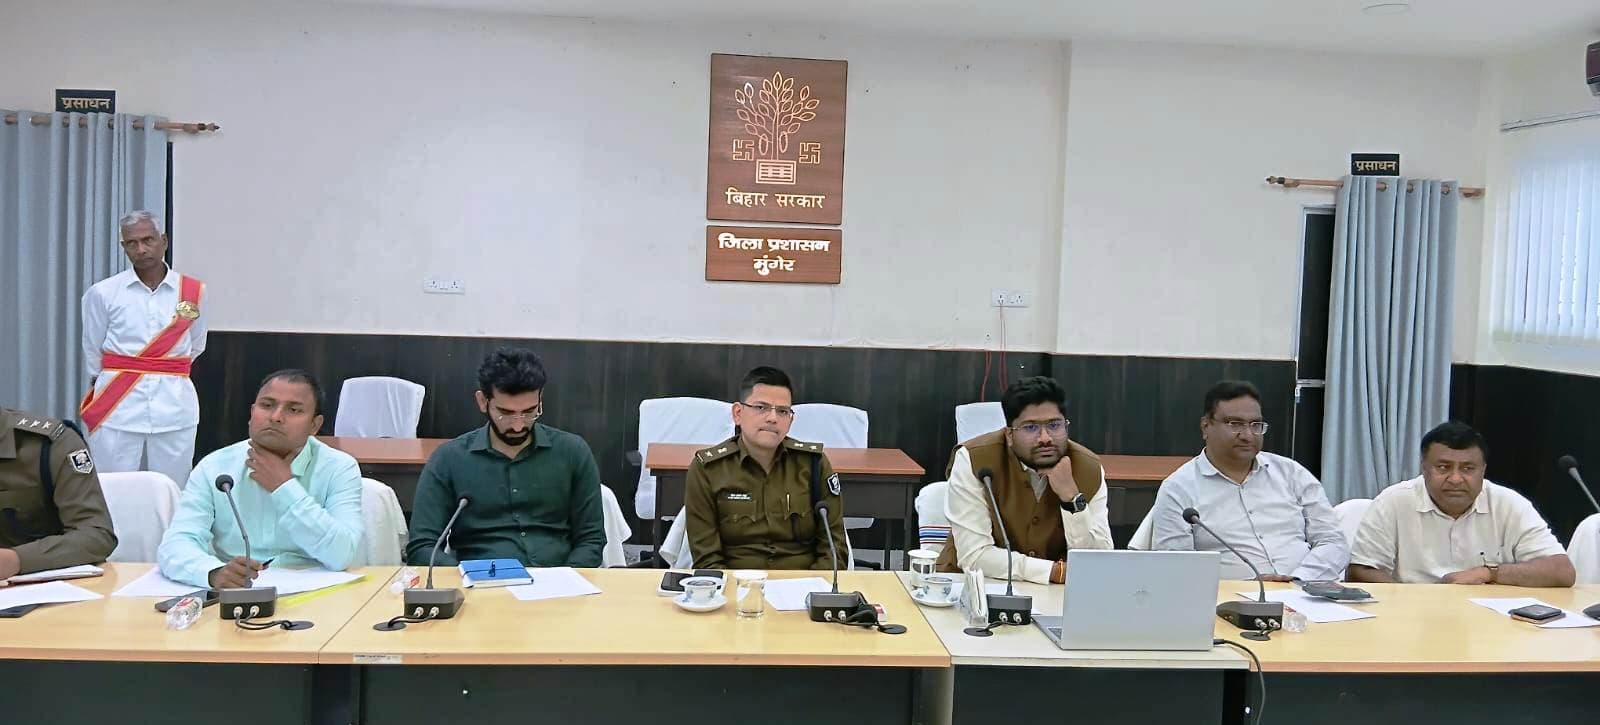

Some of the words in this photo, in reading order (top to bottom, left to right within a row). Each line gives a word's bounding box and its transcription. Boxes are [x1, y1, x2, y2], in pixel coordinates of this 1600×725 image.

[61, 97, 111, 109] प्रसाधन
[1355, 160, 1396, 172] प्रसाधन
[725, 187, 768, 208] बिहार
[775, 193, 825, 208] सरकार
[718, 232, 763, 250] जिला
[767, 238, 831, 252] प्रशासन
[753, 255, 795, 276] मुंगेर
